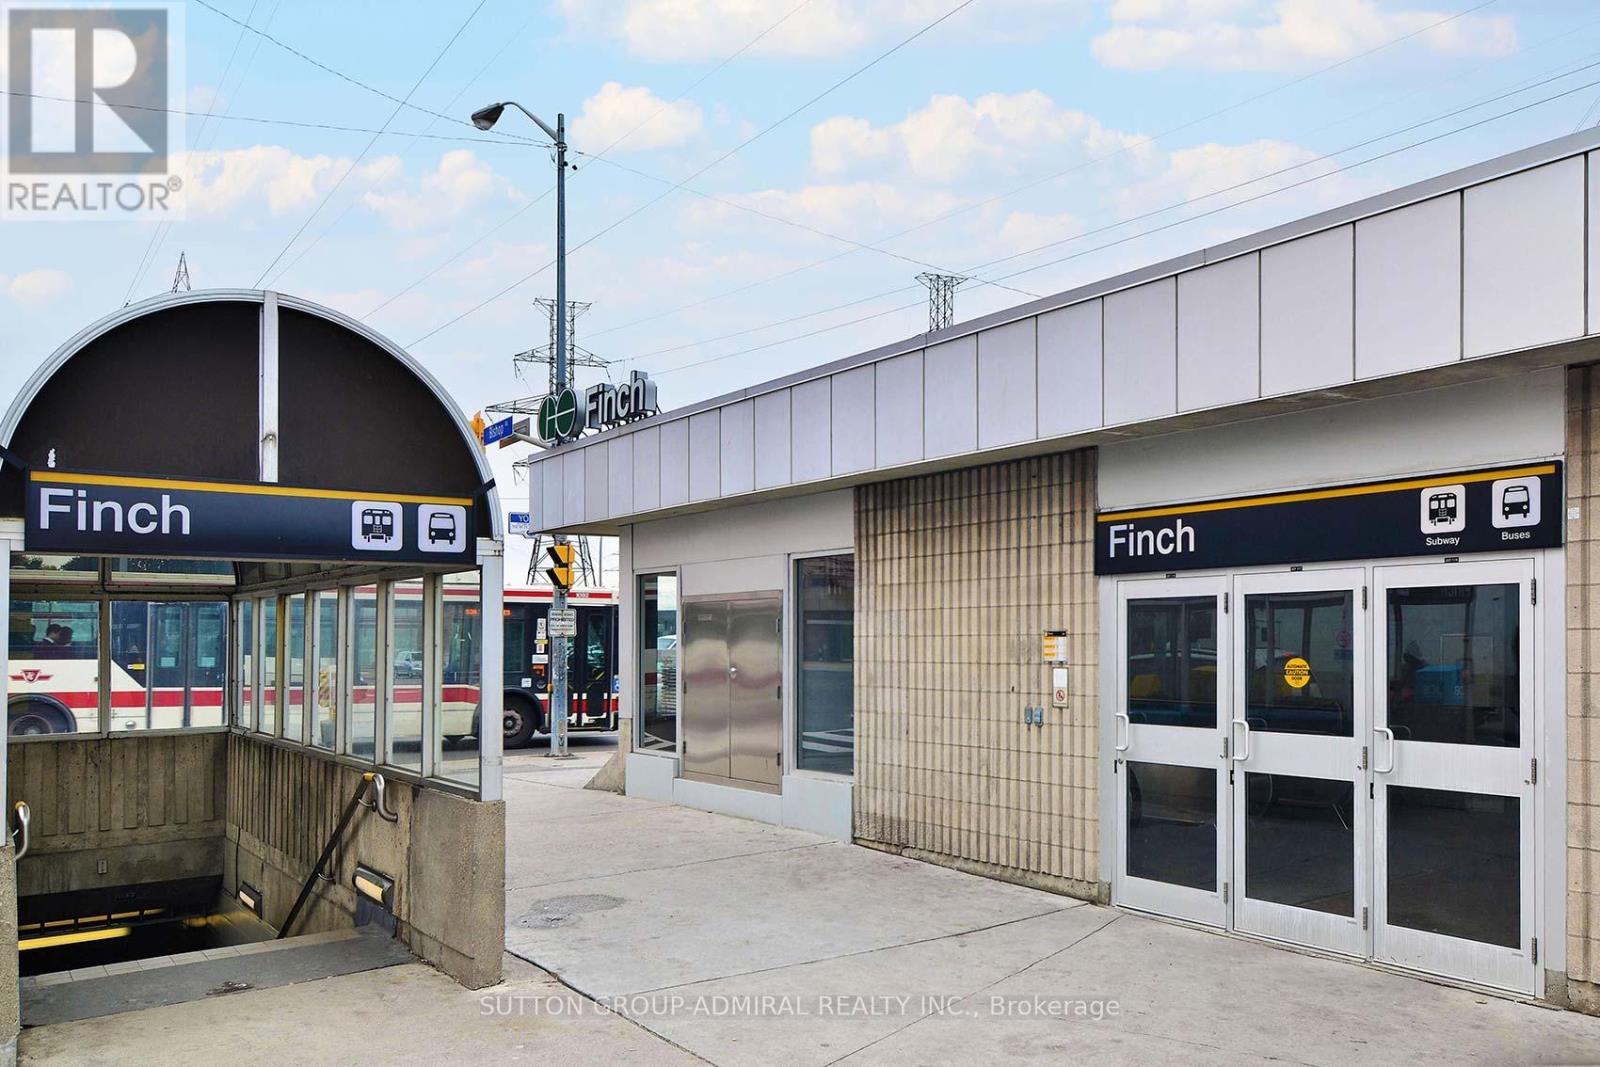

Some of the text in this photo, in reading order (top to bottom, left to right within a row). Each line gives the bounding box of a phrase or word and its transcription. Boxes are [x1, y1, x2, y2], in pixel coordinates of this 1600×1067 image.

[585, 370, 647, 429] Finch
[39, 487, 191, 536] Finch
[1109, 518, 1195, 558] Finch
[1425, 535, 1460, 548] Subway
[1501, 529, 1531, 541] Buses
